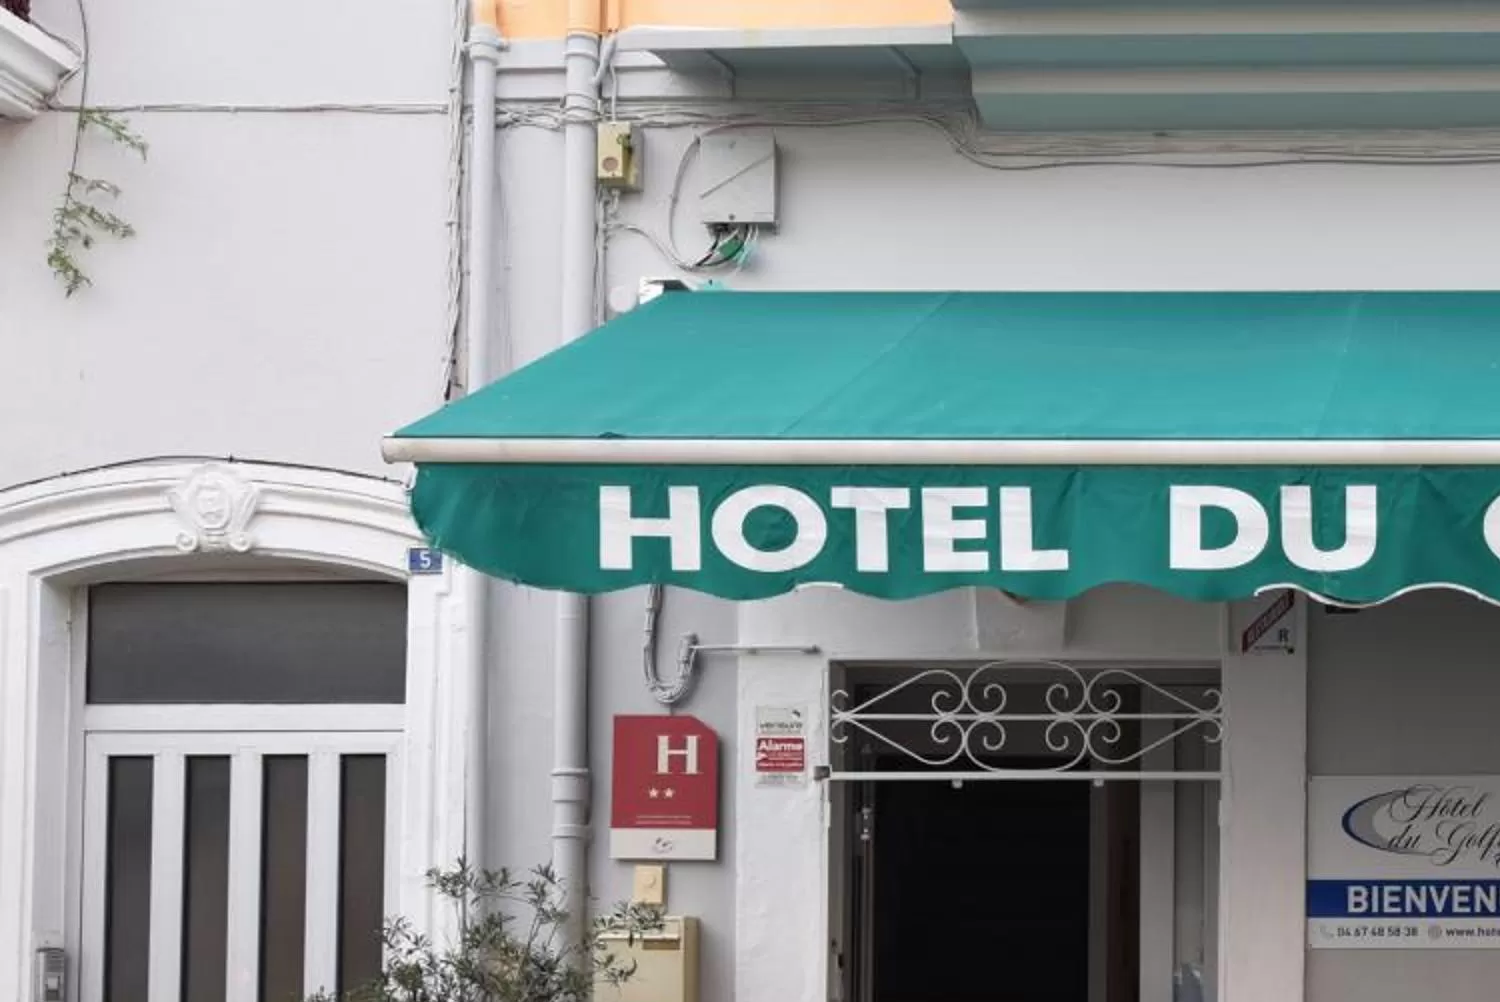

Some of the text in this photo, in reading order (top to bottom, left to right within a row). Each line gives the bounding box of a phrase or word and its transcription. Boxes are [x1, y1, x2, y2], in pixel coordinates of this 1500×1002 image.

[599, 484, 1069, 573] HOTEL
[1169, 484, 1378, 573] DU
[419, 550, 431, 569] 5
[656, 735, 702, 775] H
[1387, 823, 1422, 850] du
